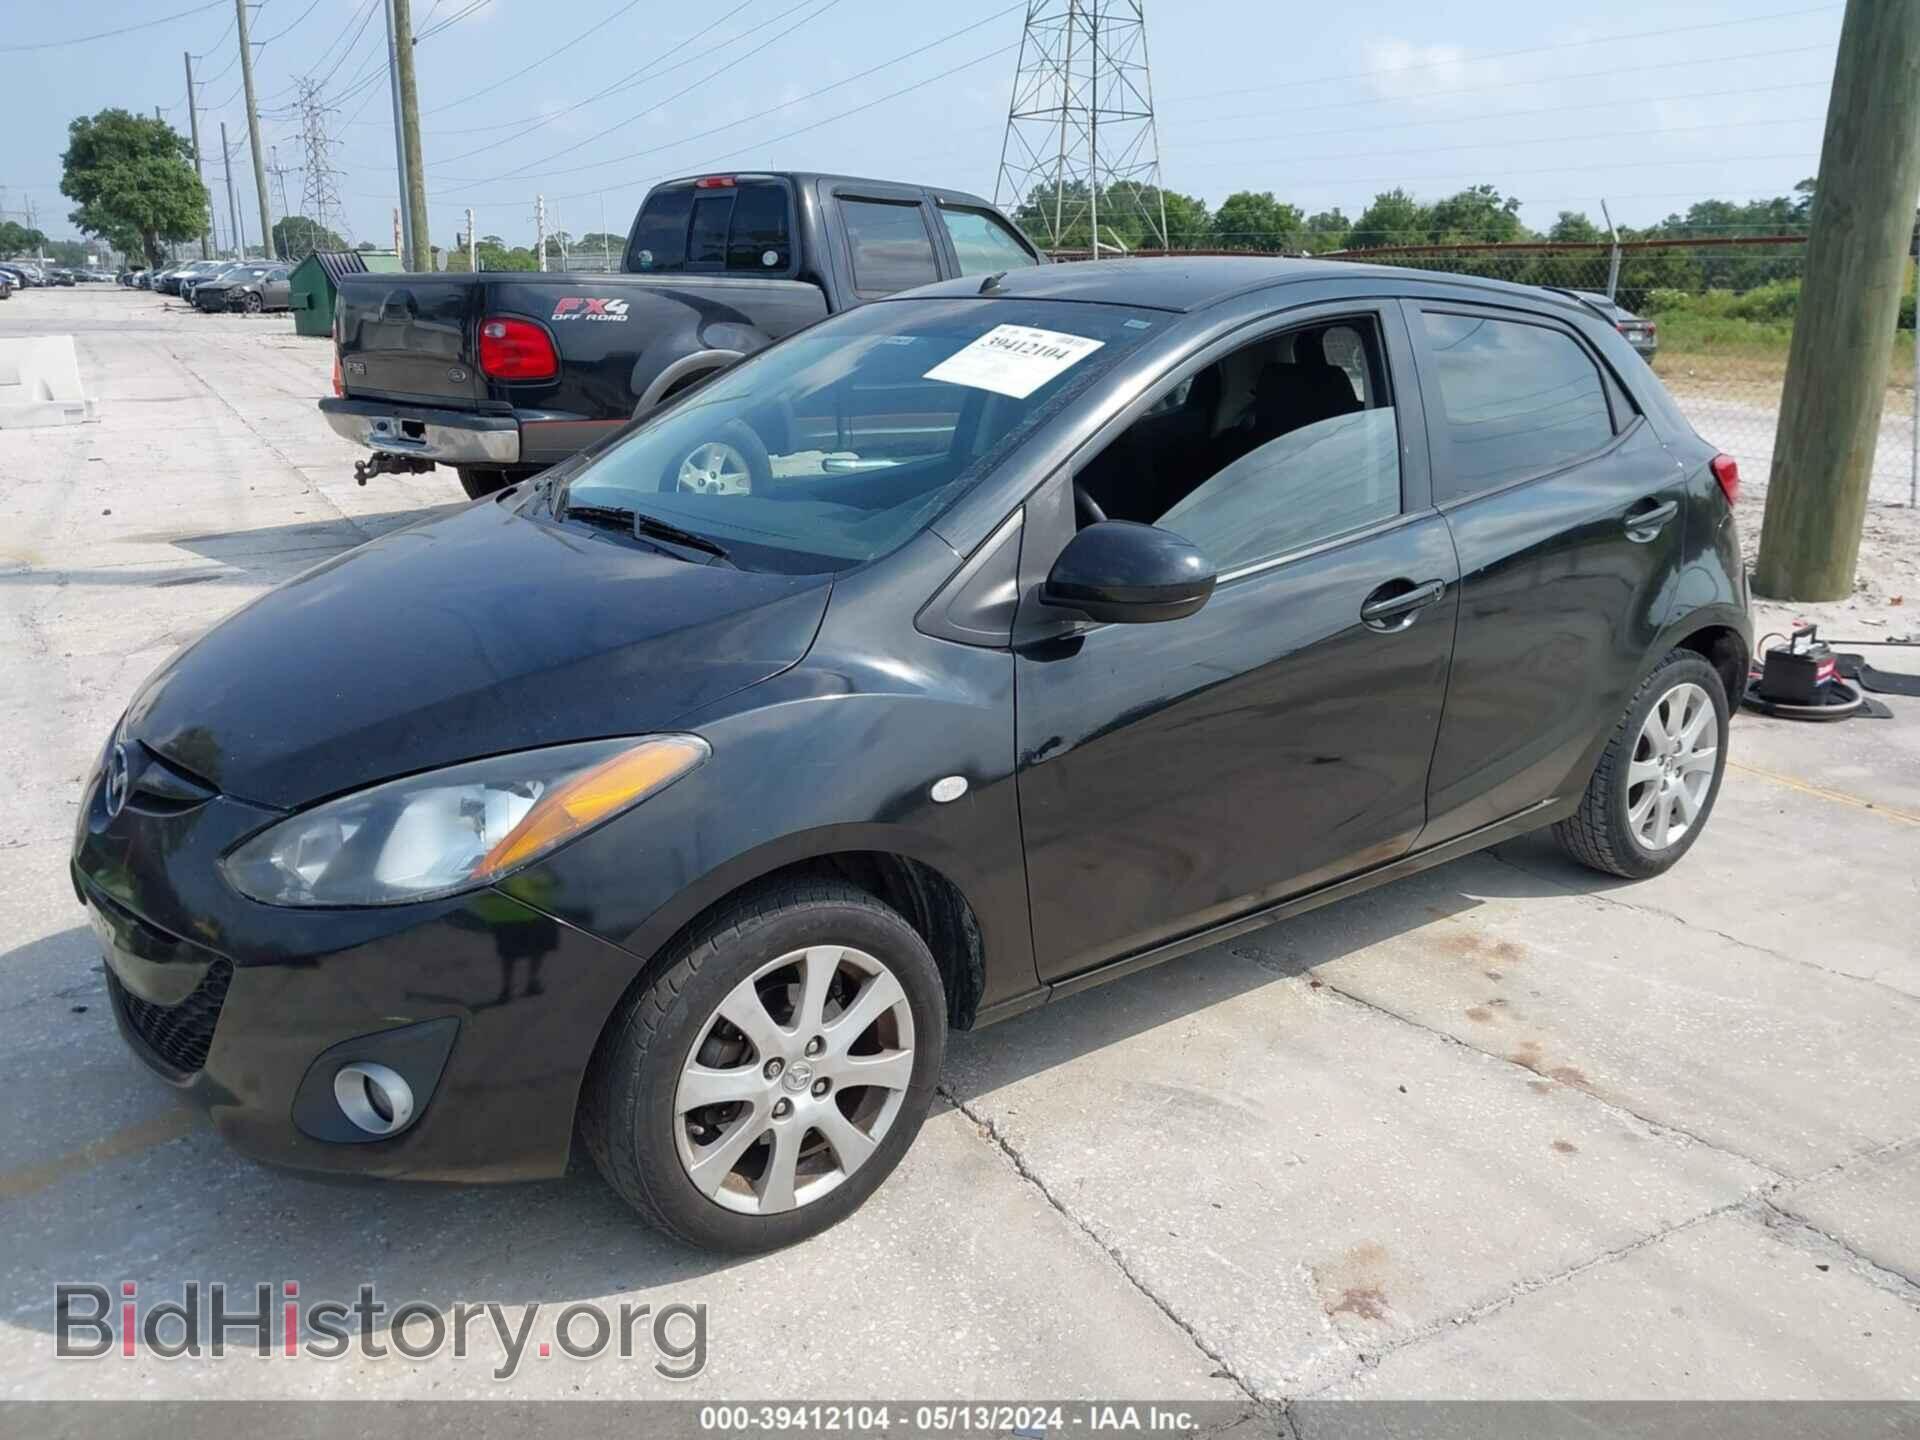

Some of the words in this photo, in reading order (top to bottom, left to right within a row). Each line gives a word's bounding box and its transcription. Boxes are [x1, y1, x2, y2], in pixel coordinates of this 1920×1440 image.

[553, 298, 629, 315] FX4
[551, 313, 582, 321] OFF
[586, 313, 628, 322] ROAD
[980, 336, 1071, 360] 39412104
